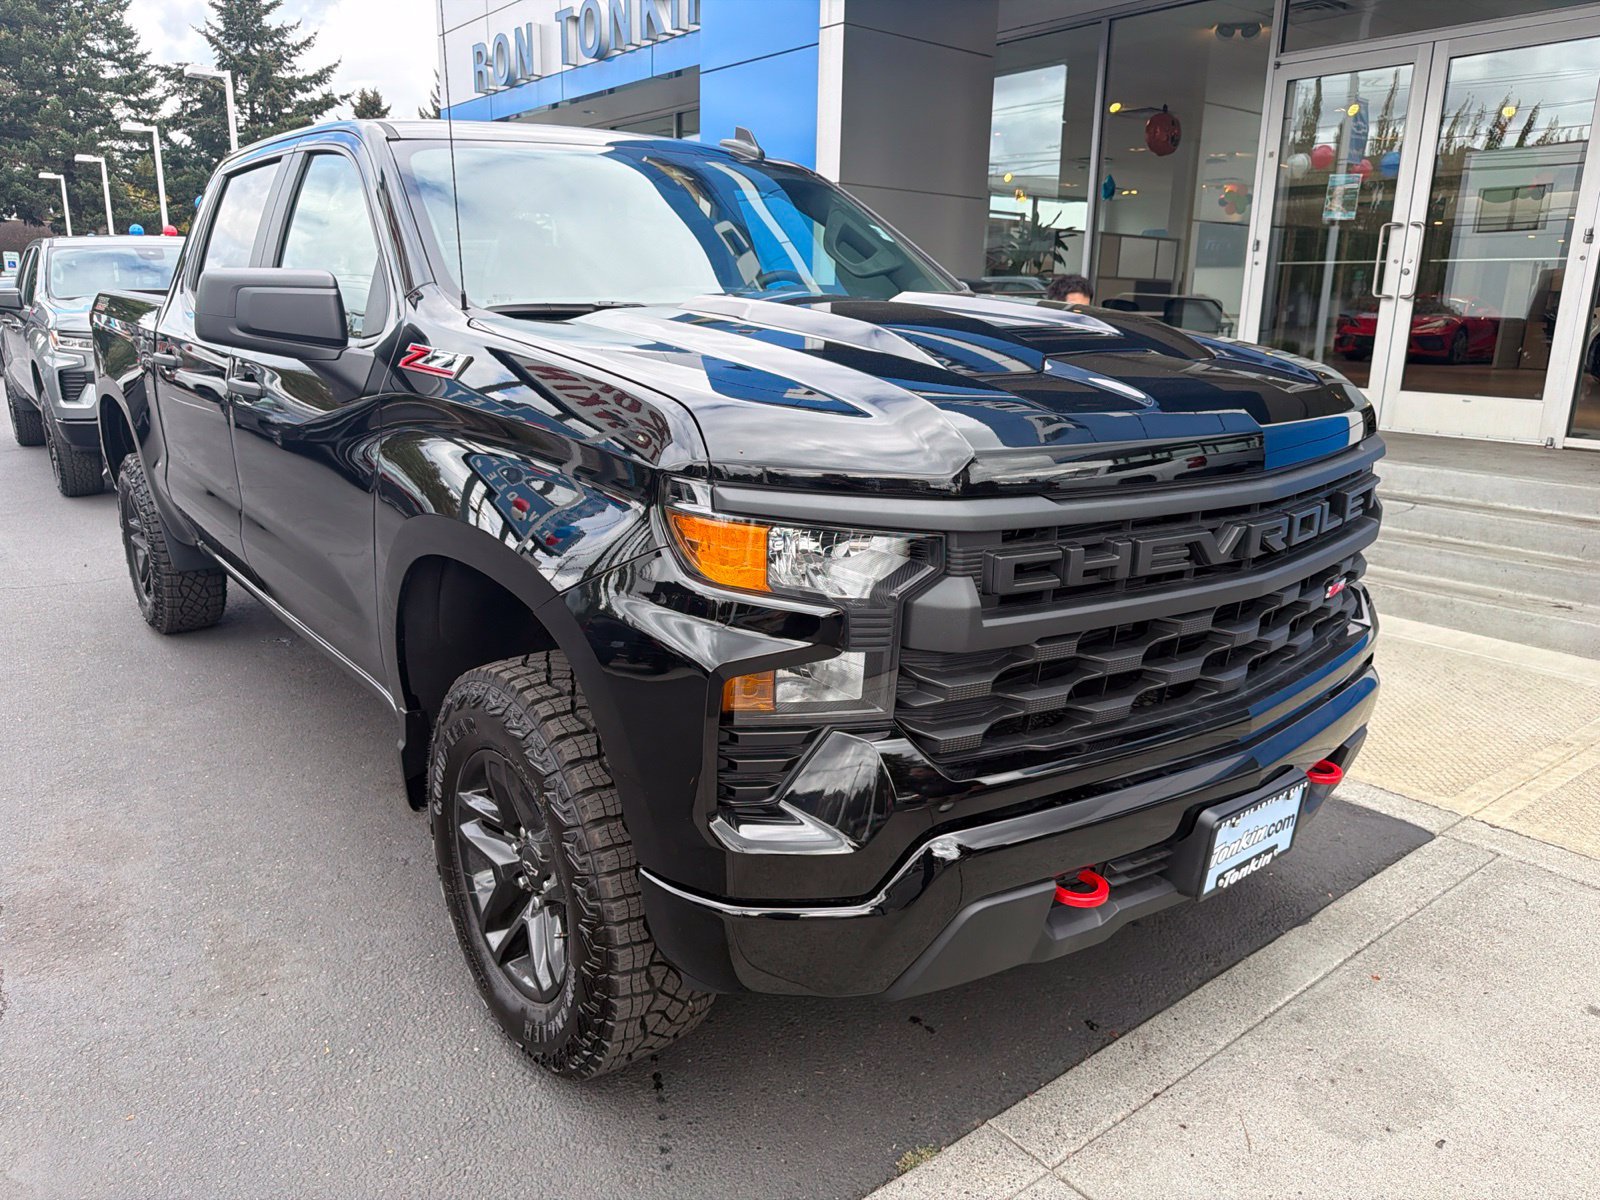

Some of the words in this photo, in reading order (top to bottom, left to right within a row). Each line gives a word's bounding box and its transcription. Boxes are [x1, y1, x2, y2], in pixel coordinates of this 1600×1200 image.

[472, 22, 541, 94] RON
[398, 342, 475, 380] Z71
[1210, 814, 1295, 869] Tonkin.com
[1222, 852, 1274, 888] Tonkin
